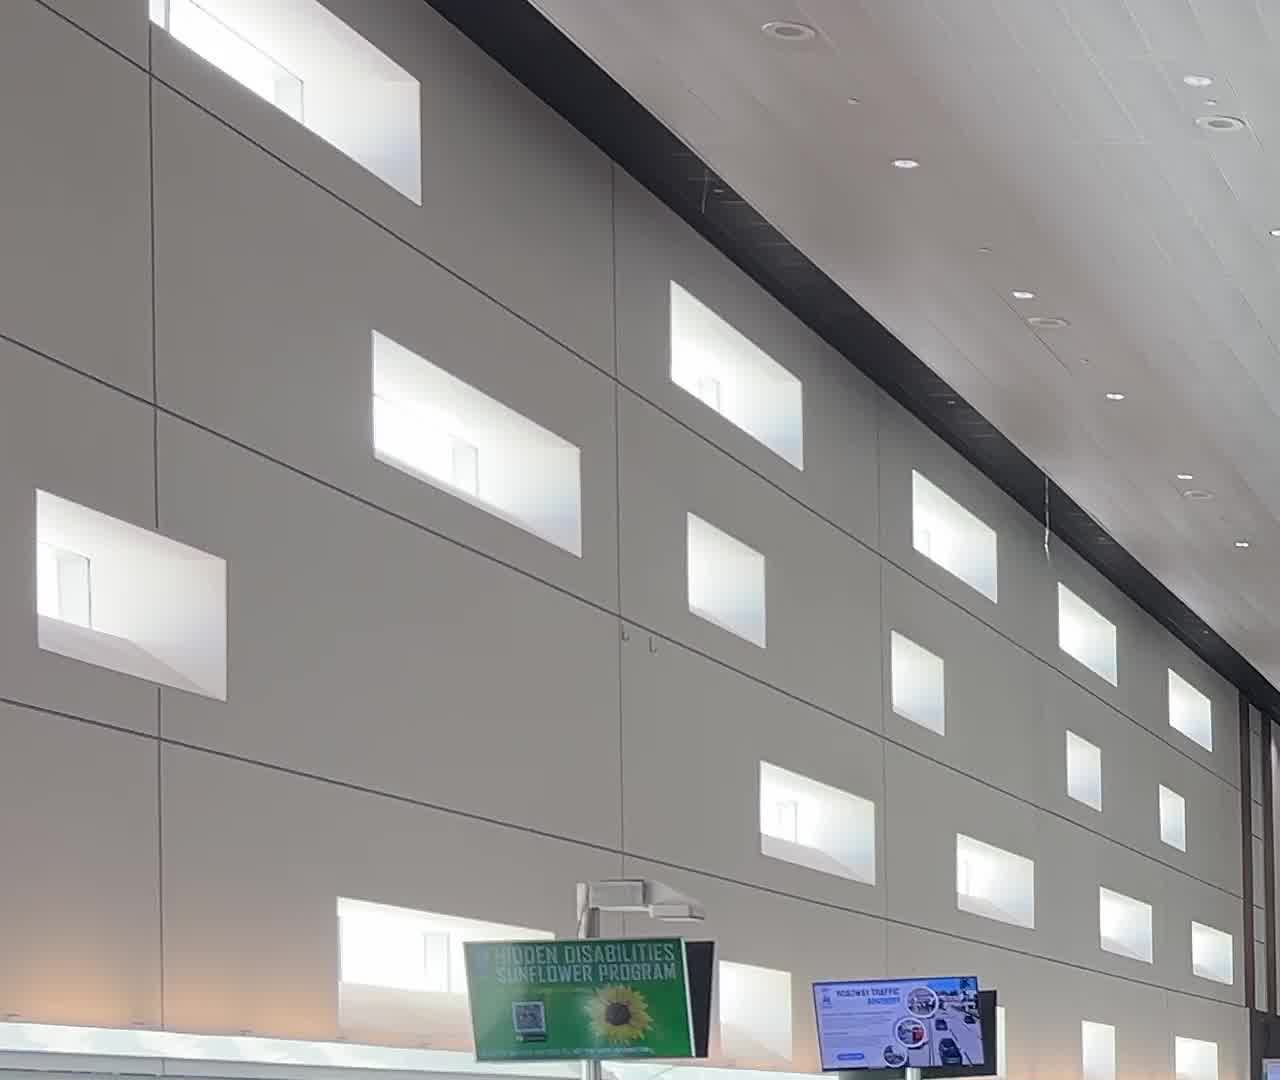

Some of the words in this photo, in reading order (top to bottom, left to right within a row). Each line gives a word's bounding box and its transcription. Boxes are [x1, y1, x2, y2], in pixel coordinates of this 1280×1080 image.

[496, 945, 558, 965] HIDDEN
[565, 943, 675, 964] DISABILITIES
[496, 964, 593, 984] SUNFLOWER
[599, 963, 677, 982] PROGRAM
